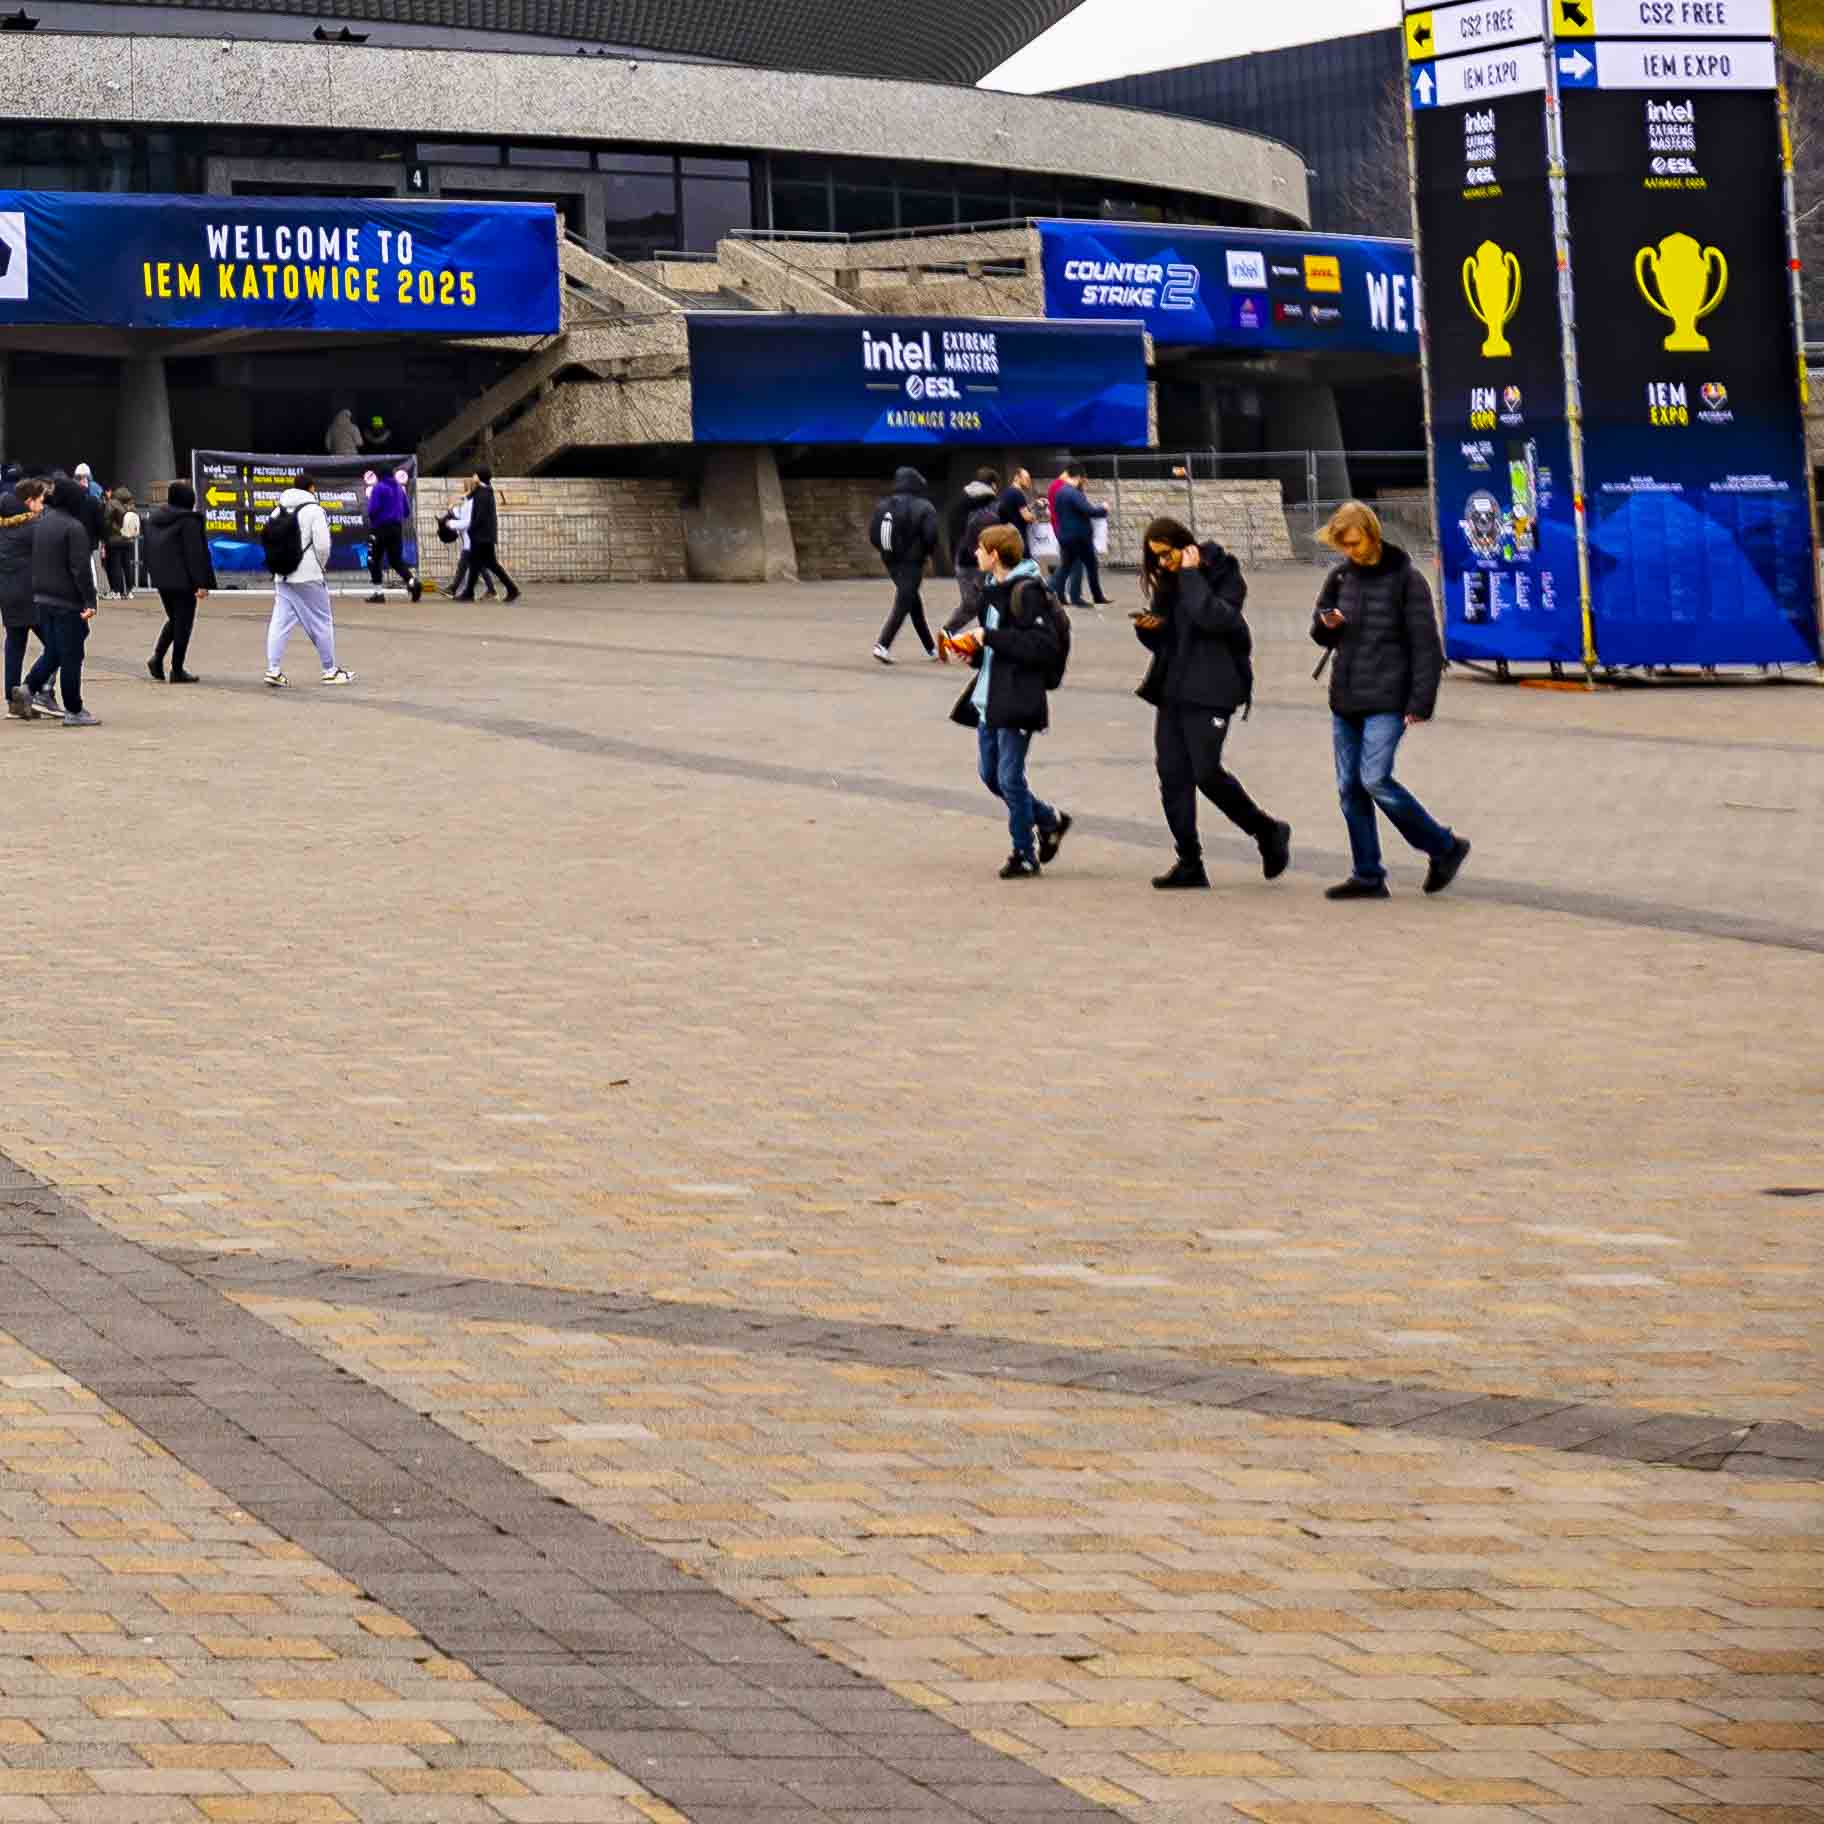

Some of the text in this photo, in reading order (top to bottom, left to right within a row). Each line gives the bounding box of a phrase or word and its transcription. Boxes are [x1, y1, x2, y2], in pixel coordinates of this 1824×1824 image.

[1459, 7, 1515, 39] CS2 FREE
[1639, 2, 1726, 25] CS2 FREE
[1463, 59, 1520, 90] IEM EXPO
[1643, 54, 1732, 77] IEM EXPO
[1667, 157, 1698, 174] ESL
[413, 169, 423, 188] 4
[206, 224, 414, 265] WELCOME TO
[1063, 259, 1163, 284] COUNTER
[143, 262, 478, 306] IEM KATOWICE 2025
[1160, 262, 1201, 310] 2
[1080, 285, 1157, 309] STRIKE
[942, 330, 997, 353] EXTREME
[943, 351, 1000, 375] MASTERS
[924, 376, 963, 400] ESL
[1470, 387, 1497, 411] IEM
[1648, 381, 1688, 407] IEM
[886, 408, 945, 430] KATOWICE
[1649, 406, 1689, 426] EXPO
